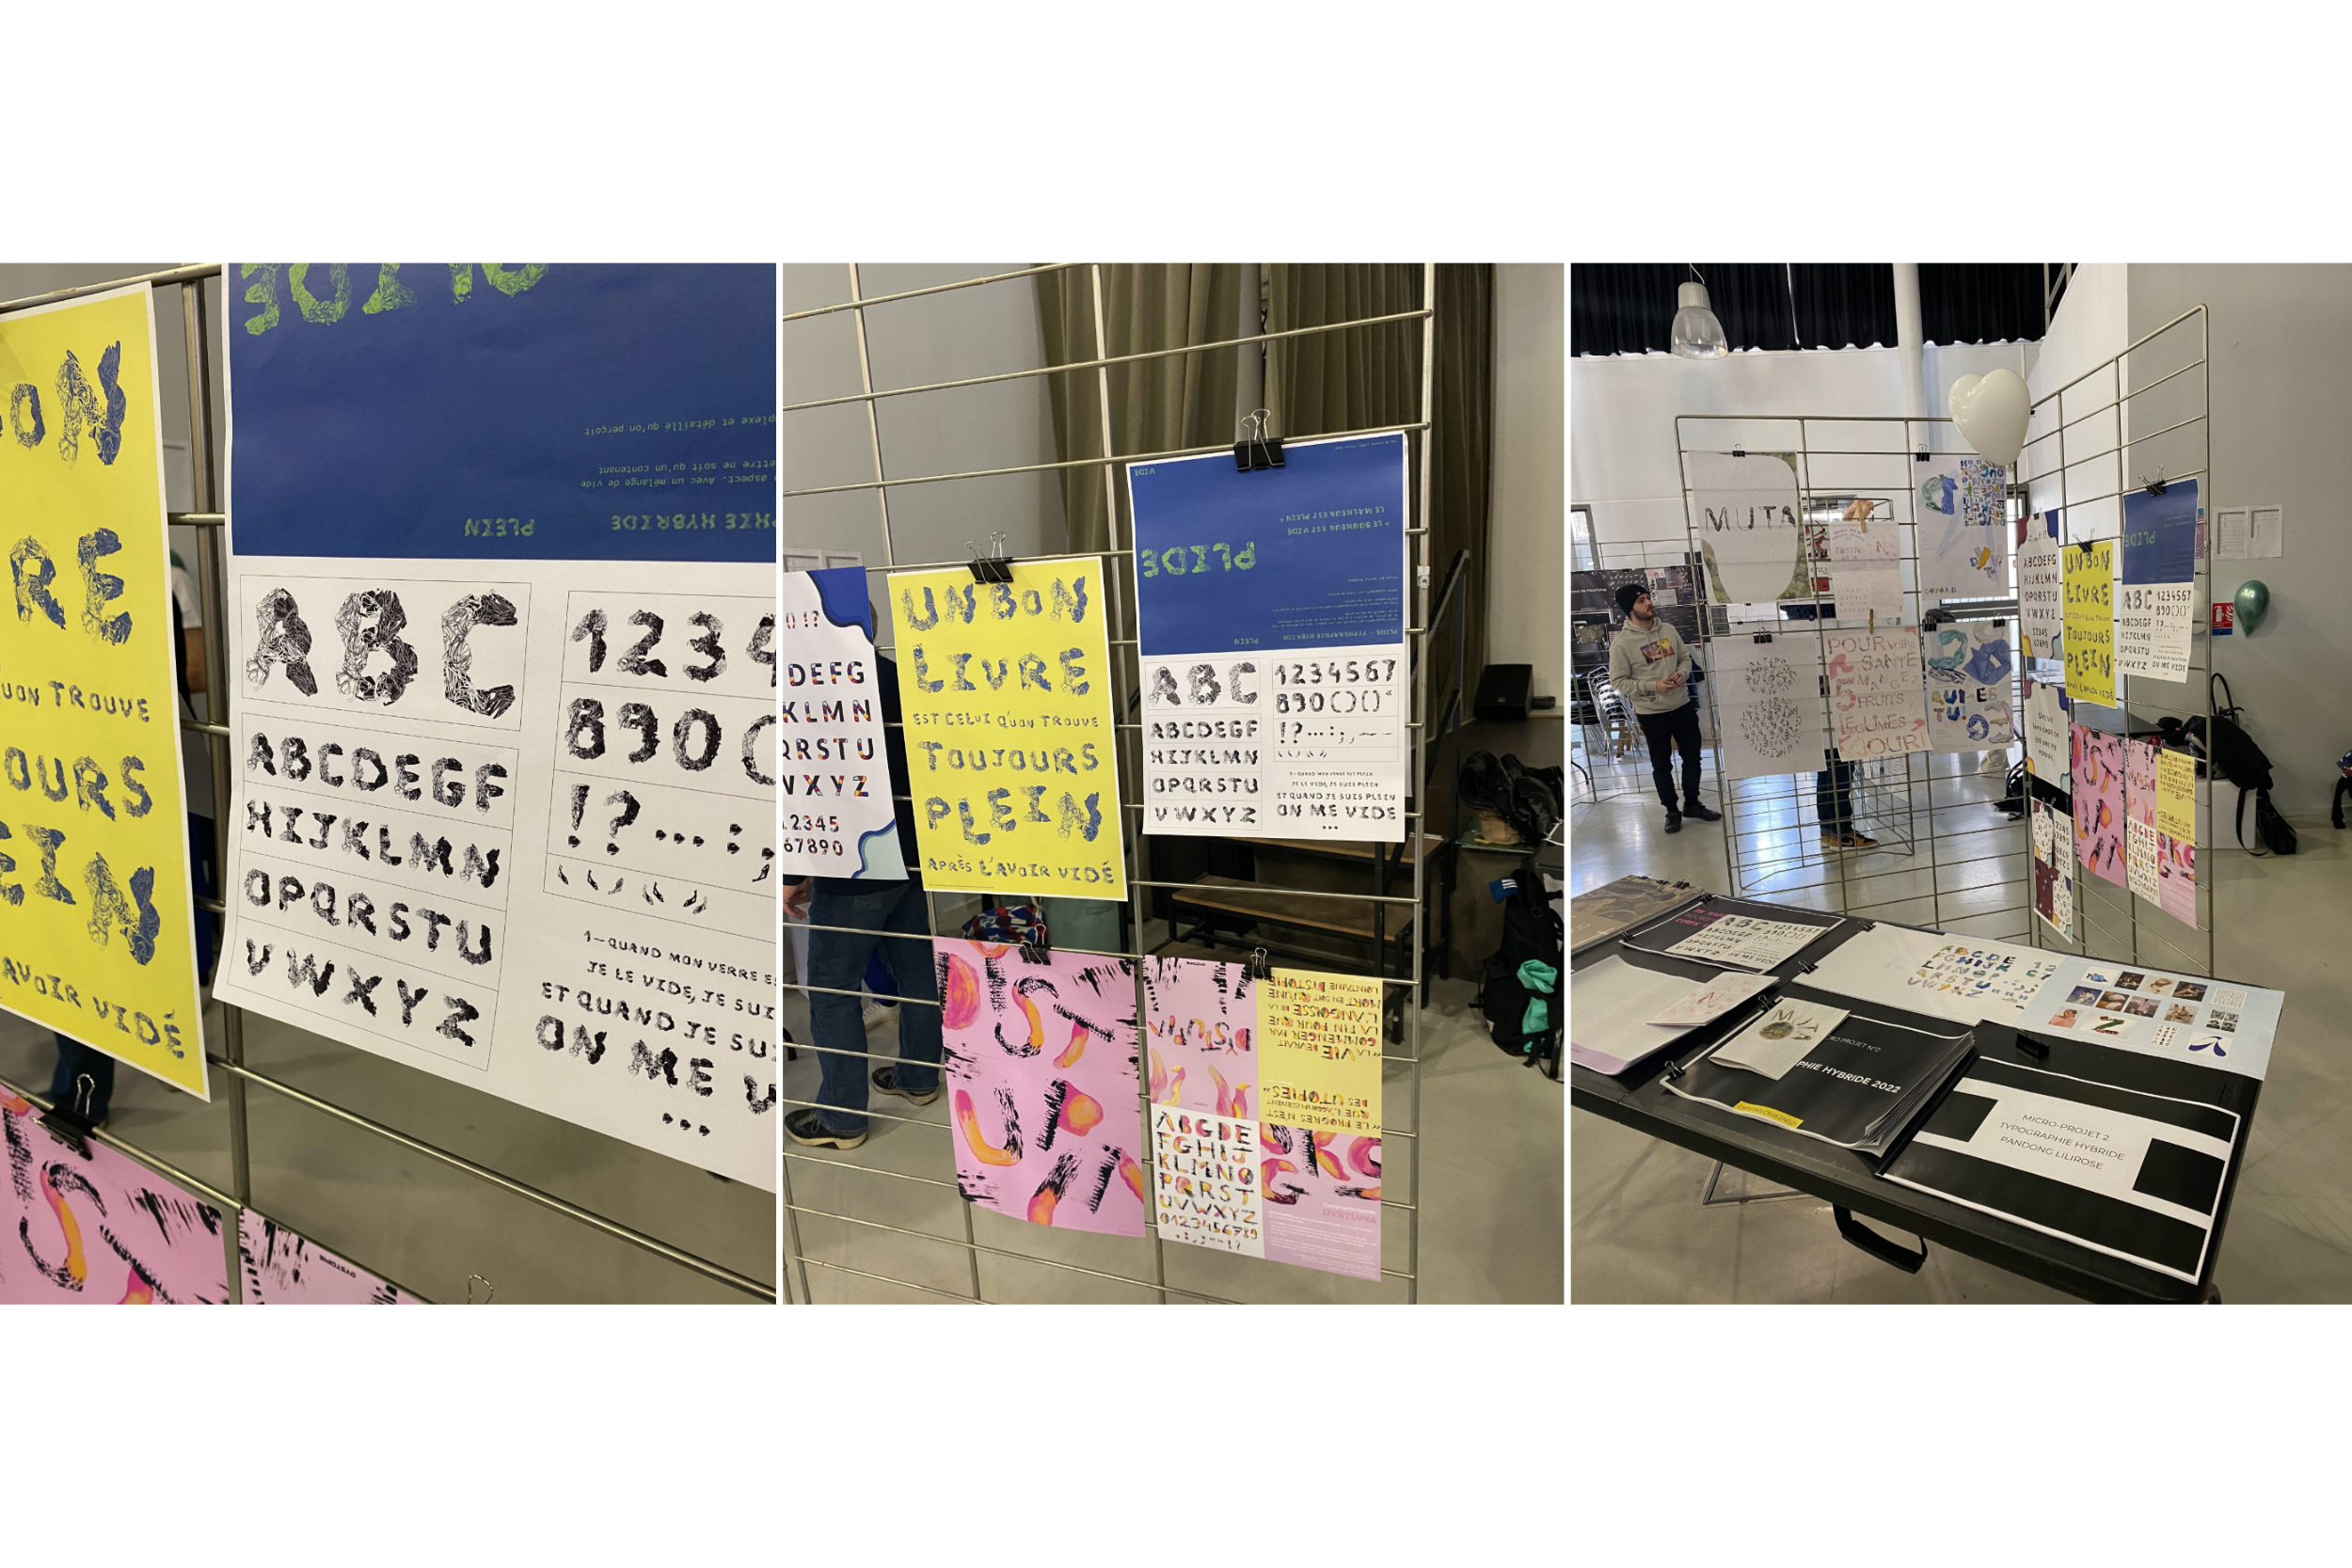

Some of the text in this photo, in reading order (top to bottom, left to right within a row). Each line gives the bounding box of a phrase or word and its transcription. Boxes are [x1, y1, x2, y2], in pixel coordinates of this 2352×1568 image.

[584, 424, 624, 436] perçoit
[665, 419, 715, 432] détaillé
[723, 418, 735, 426] et
[598, 465, 649, 474] contenant
[1134, 467, 1155, 477] VIDE
[580, 480, 602, 488] vide
[609, 480, 619, 488] de
[625, 477, 666, 488] mélange
[691, 476, 715, 485] Avec
[723, 475, 767, 483] aspect.
[1286, 514, 1310, 522] PLEIN
[1330, 508, 1373, 517] MALHEUR
[1705, 505, 1797, 531] MUTA
[465, 516, 535, 537] PLEIN
[612, 513, 716, 531] HYBRIDE
[1329, 521, 1371, 531] BONHEUR
[2124, 531, 2155, 547] PLIDE
[1140, 540, 1257, 578] PLIDE
[2064, 552, 2083, 575] UN
[2066, 580, 2109, 607] LIVRE
[901, 583, 977, 632] UN
[1233, 637, 1259, 645] PLEIN
[2066, 626, 2110, 644] TOUJOURS
[1827, 636, 1886, 655] POUR
[1862, 649, 1917, 671] SANTÉ
[2067, 649, 2111, 678] PLEIN
[2171, 663, 2186, 672] VIDE
[913, 643, 1090, 697] LIVRE
[48, 680, 150, 722] TROUVE
[1857, 693, 1904, 708] FRUITS
[2099, 683, 2114, 701] VIDÉ
[913, 712, 939, 725] EST
[945, 712, 991, 726] CELUI
[1040, 715, 1099, 728] TROUVE
[916, 741, 1099, 775] TOUJOURS
[4, 745, 152, 822] OURS
[925, 785, 1103, 846] PLEIN
[1277, 803, 1396, 819] ON ME VIDE
[928, 853, 1115, 884] APRÈS L'AVOIR VIDÉ
[669, 952, 757, 982] MON VERRE
[587, 960, 607, 975] JE
[615, 967, 633, 983] LE
[702, 990, 724, 1006] JE
[1268, 976, 1378, 994] LOINTAINE DYSTOPIE
[2, 955, 184, 1059] AVOIR VIDÉ
[1345, 998, 1381, 1008] MORT
[542, 981, 716, 1045] ET QUAND JE
[1293, 1004, 1377, 1023] L'ANGOISSE
[1268, 1016, 1378, 1036] LA FIN POUR QUE
[1269, 1028, 1287, 1037] PAR
[1278, 1039, 1318, 1052] DEVRAIT
[1841, 1036, 1867, 1048] PROJET
[535, 1014, 714, 1098] ON ME
[1321, 1045, 1356, 1061] VIE
[1796, 1060, 1901, 1093] PHIE HYBRIDE 2022
[1348, 1097, 1367, 1107] DES
[1266, 1109, 1370, 1130] LE PROGRES N'EST
[1344, 1109, 1369, 1119] QUE
[2022, 1115, 2102, 1139] MICRO-PROJET
[2000, 1122, 2125, 1161] TYPOGRAPHIE HYBRIDE
[2000, 1136, 2104, 1170] PANDONG LILIROSE
